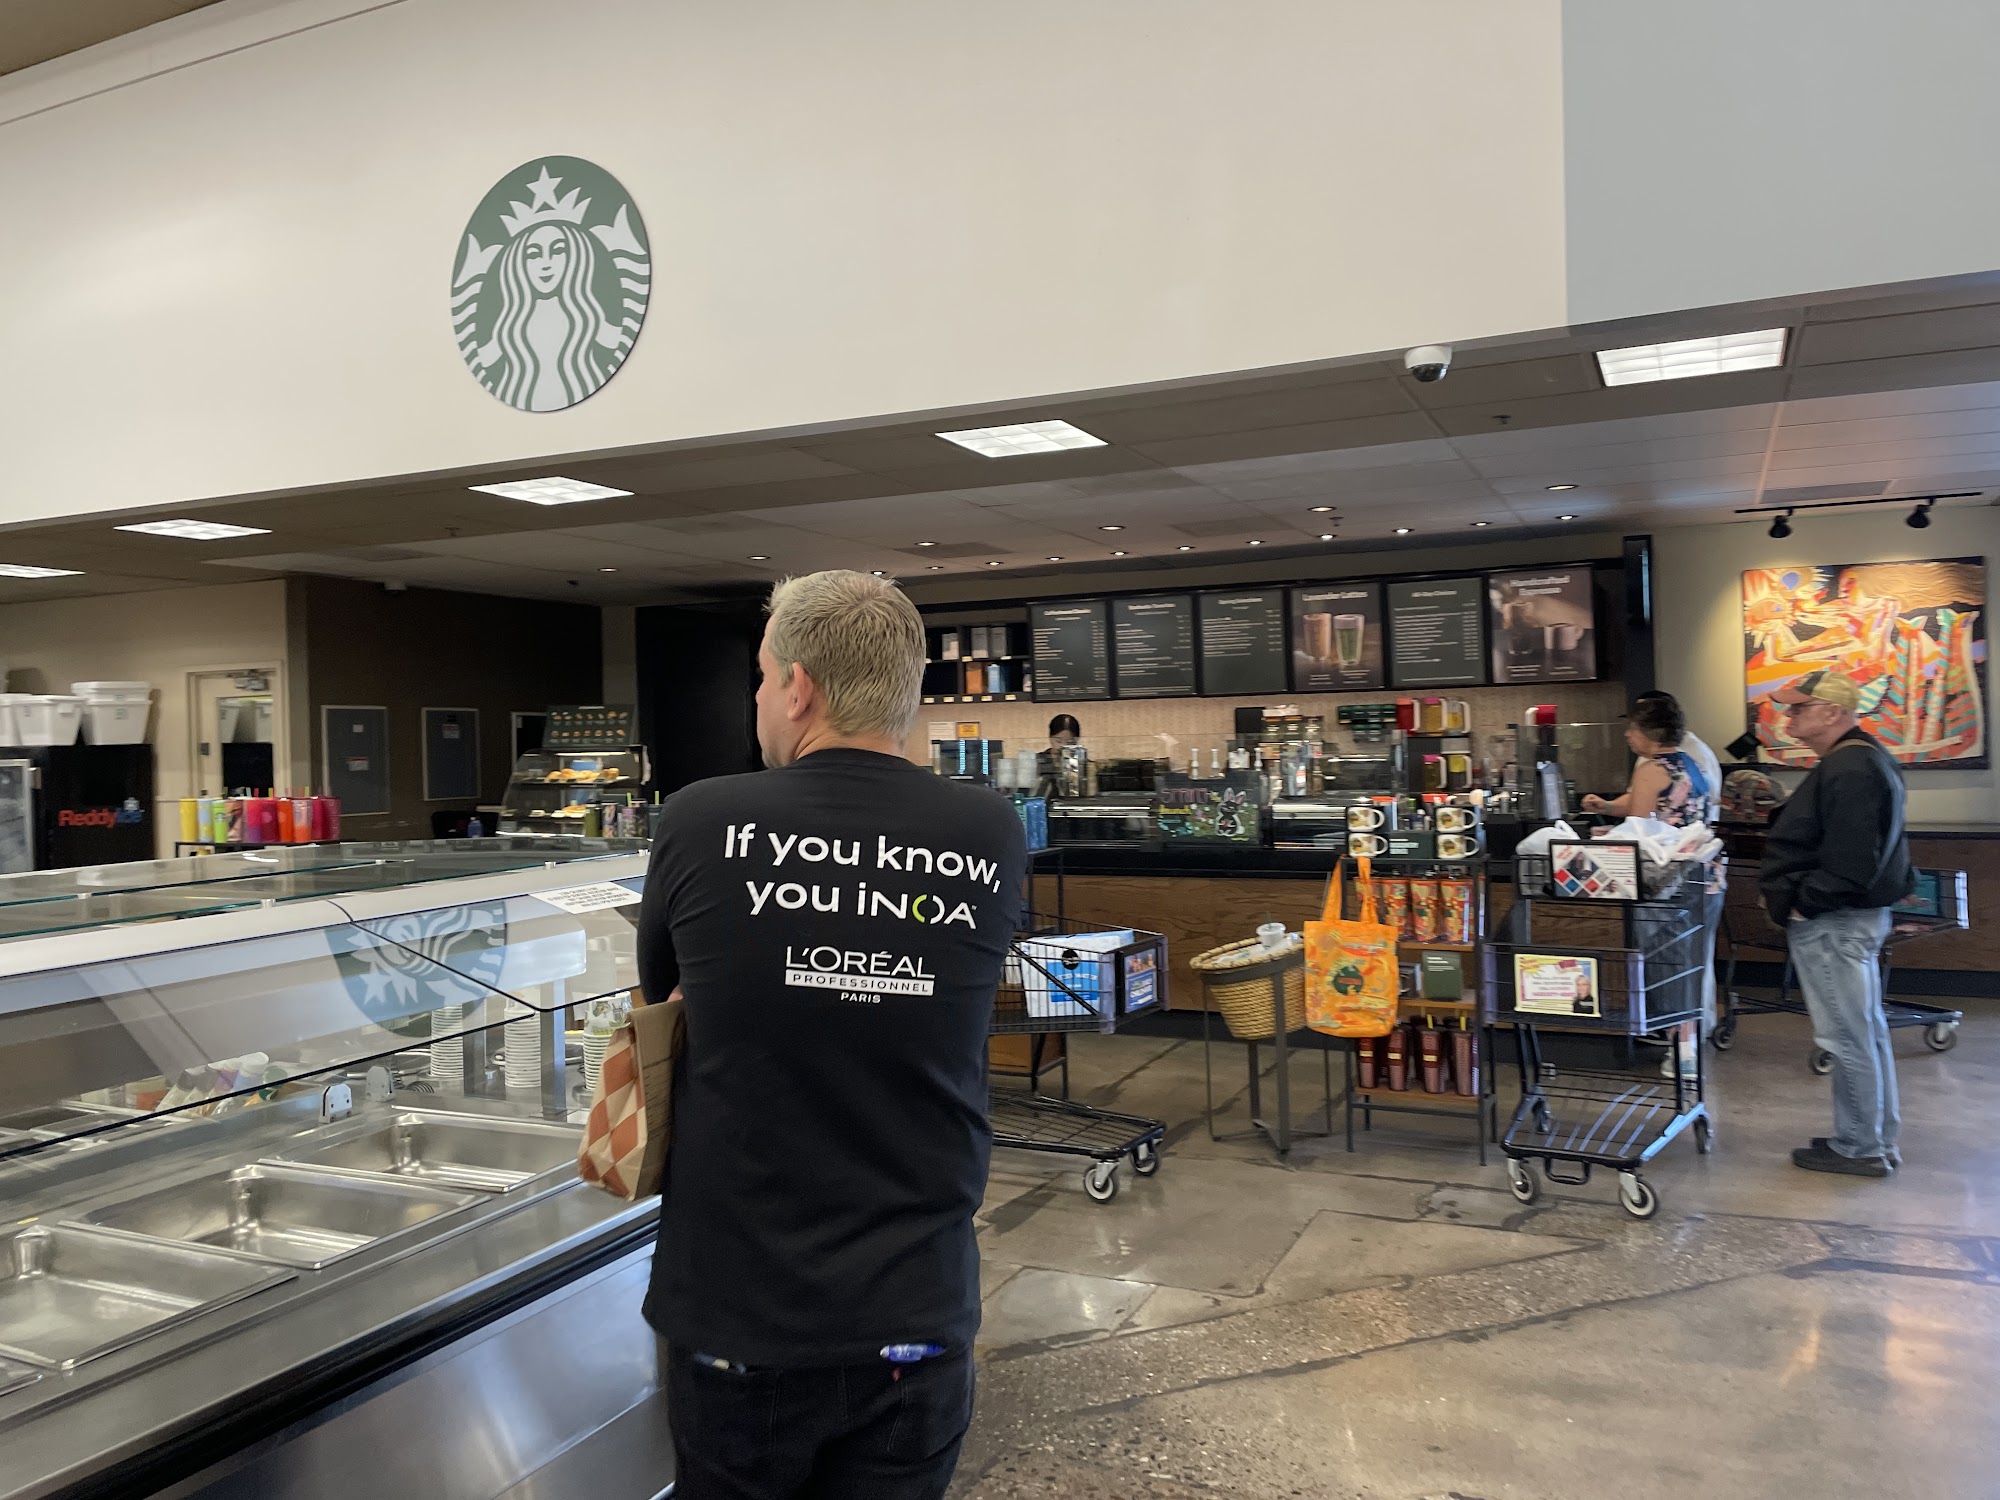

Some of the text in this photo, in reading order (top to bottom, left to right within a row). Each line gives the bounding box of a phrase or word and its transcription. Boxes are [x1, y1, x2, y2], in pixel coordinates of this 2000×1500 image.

[724, 823, 1000, 893] If you know,
[746, 881, 840, 916] you
[786, 945, 935, 979] L'ORÉAL
[793, 974, 928, 992] PROFESSIONNEL
[840, 992, 881, 1004] PARIS
